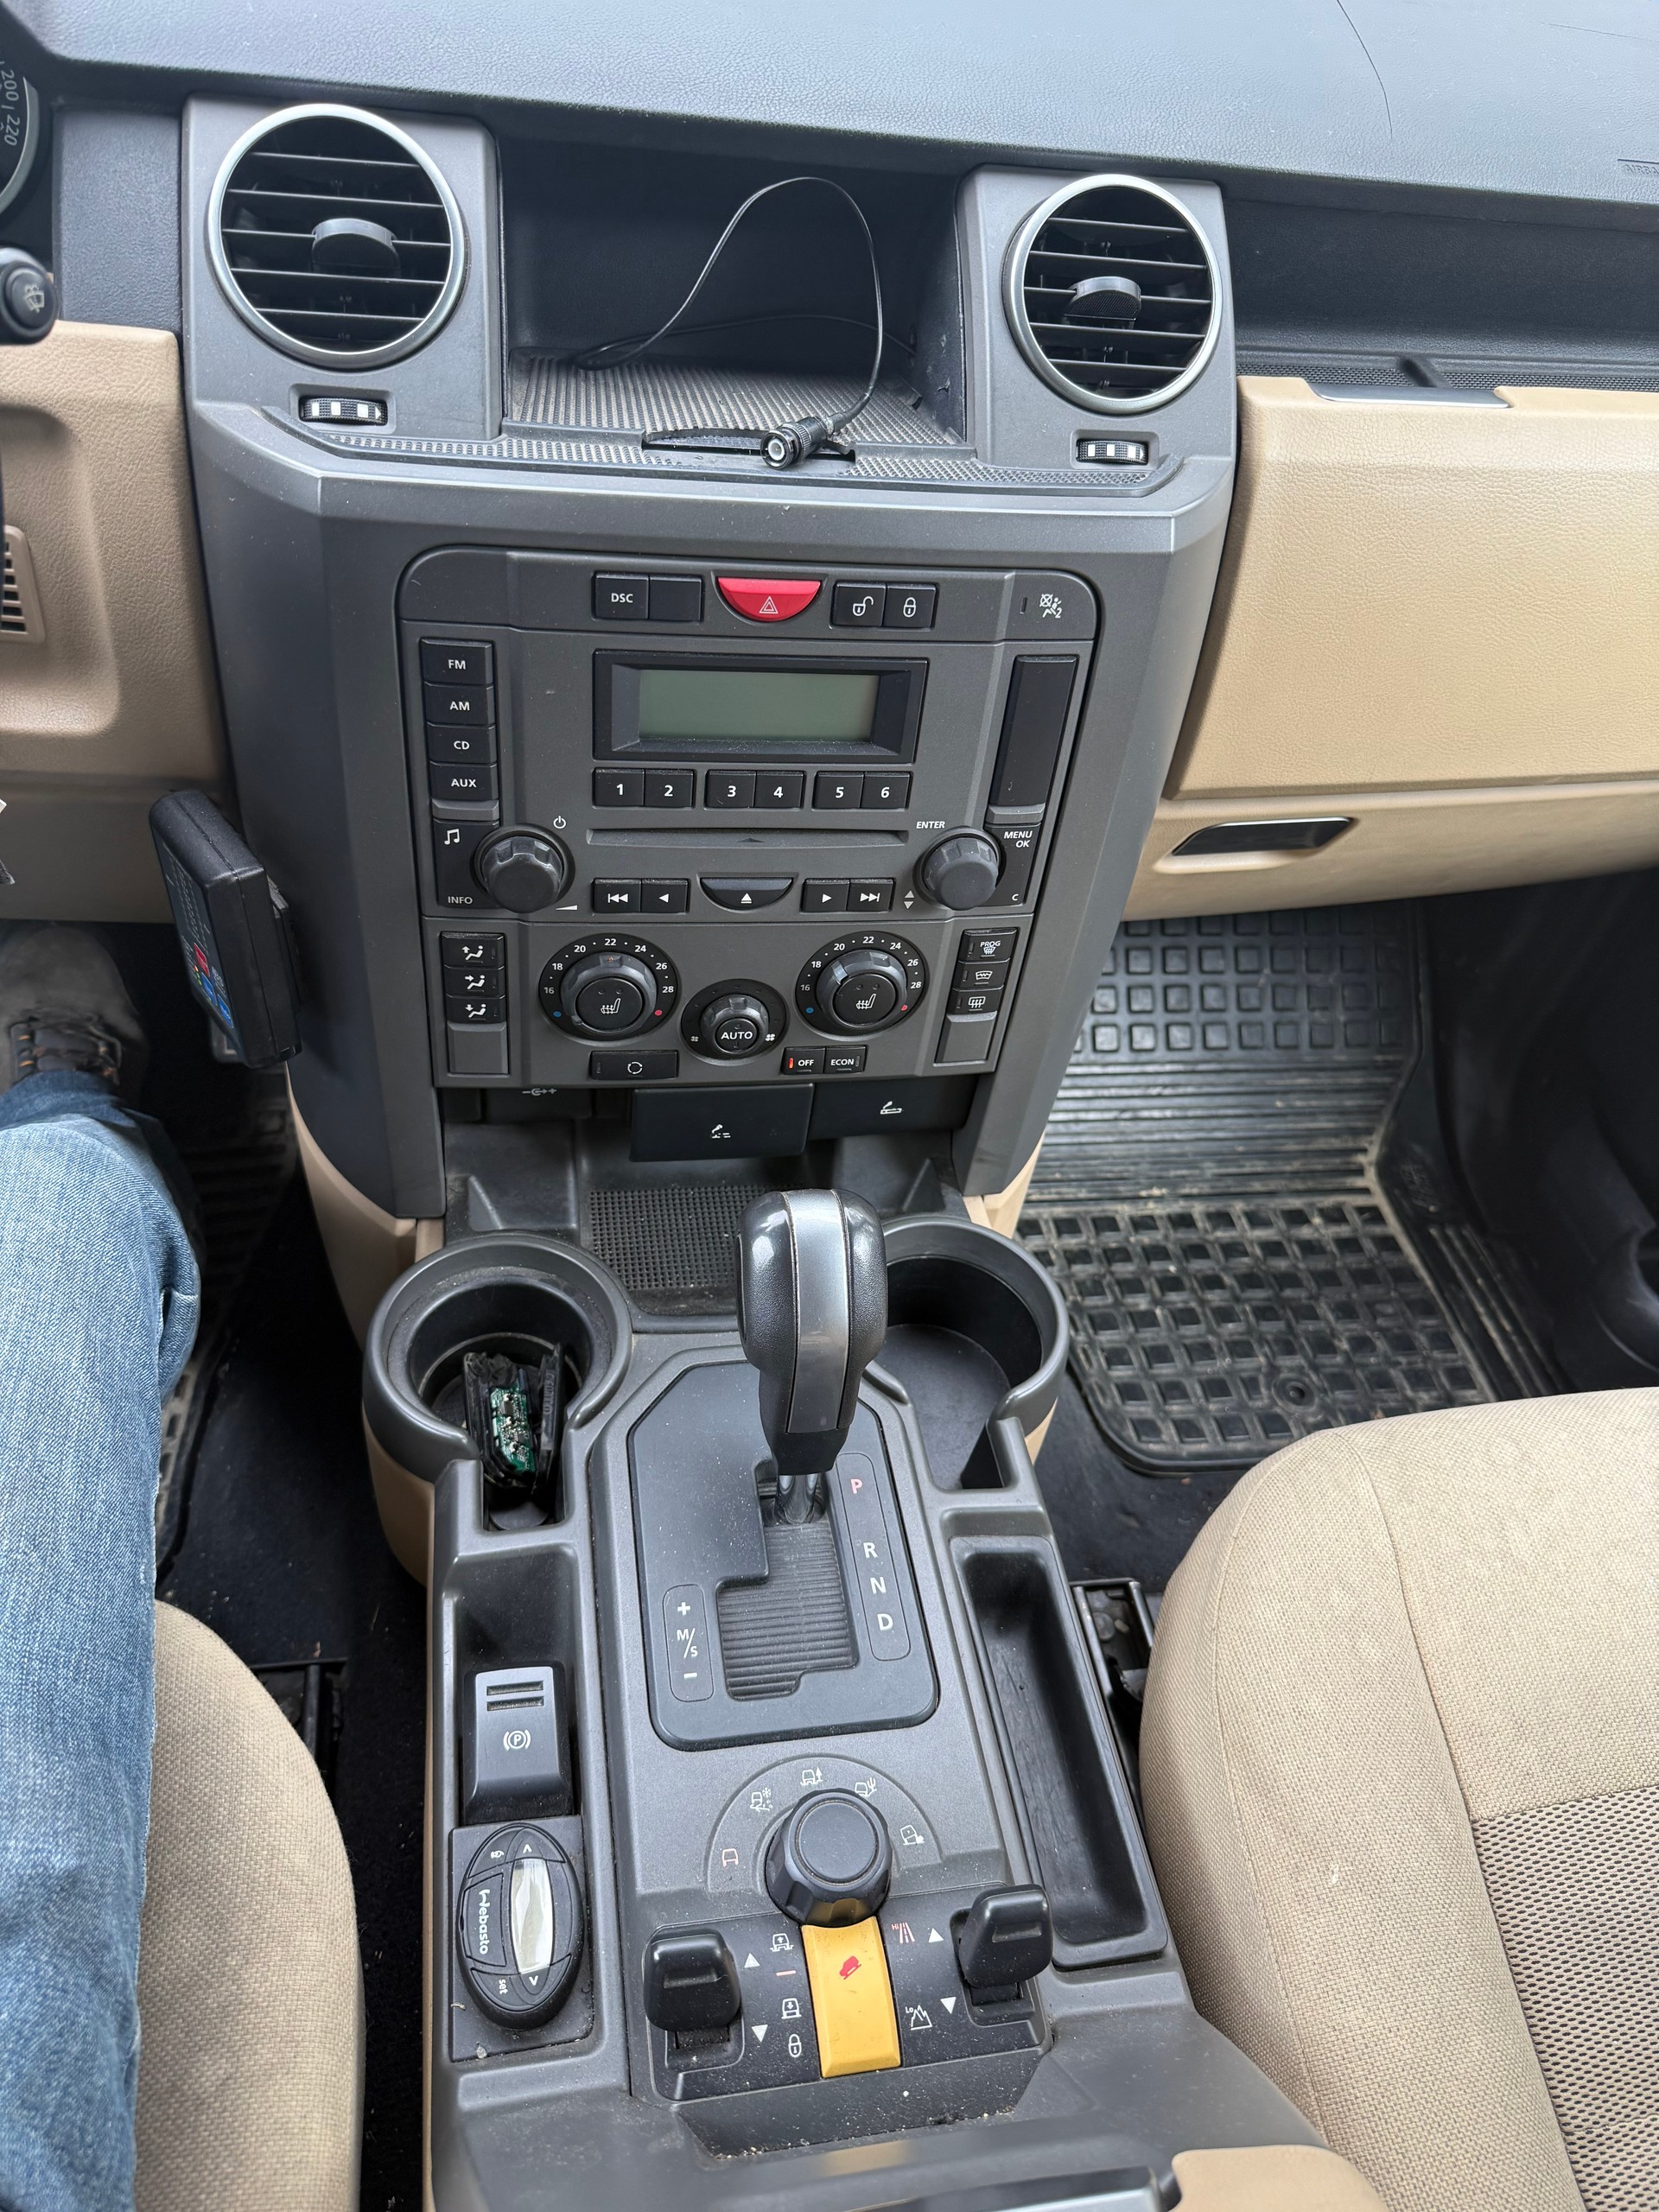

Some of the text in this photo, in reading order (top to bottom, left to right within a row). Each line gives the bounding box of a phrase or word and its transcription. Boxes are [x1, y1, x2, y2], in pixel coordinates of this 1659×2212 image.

[1, 69, 19, 101] 200
[3, 113, 21, 146] 220
[611, 593, 633, 603] DSC
[448, 659, 467, 670] FM
[449, 701, 470, 711] AM
[453, 741, 470, 750] CD
[450, 778, 477, 788] AUX
[616, 783, 624, 796] 1
[664, 785, 673, 797] 2
[727, 785, 737, 798] 3
[773, 786, 784, 798] 4
[835, 786, 844, 798] 5
[880, 786, 890, 798] 6
[916, 820, 946, 830] ENTER
[1003, 830, 1033, 841] MENU
[1015, 839, 1031, 849] OK
[448, 896, 474, 905] INFO
[862, 936, 874, 944] 22
[833, 943, 846, 951] 20
[889, 942, 901, 950] 24
[543, 986, 555, 995] 16
[574, 944, 587, 953] 20
[604, 938, 617, 946] 22
[634, 944, 647, 953] 24
[655, 962, 668, 970] 26
[662, 985, 674, 994] 28
[810, 960, 822, 969] 18
[906, 958, 918, 967] 26
[910, 981, 922, 989] 28
[721, 1031, 753, 1040] AUTO
[798, 1058, 815, 1067] OFF
[850, 1478, 863, 1495] P
[862, 1541, 879, 1559] R
[869, 1576, 887, 1595] N
[876, 1612, 895, 1632] D
[478, 1889, 491, 1955] Webasto
[498, 1979, 509, 1995] set
[905, 2005, 915, 2015] Lo
